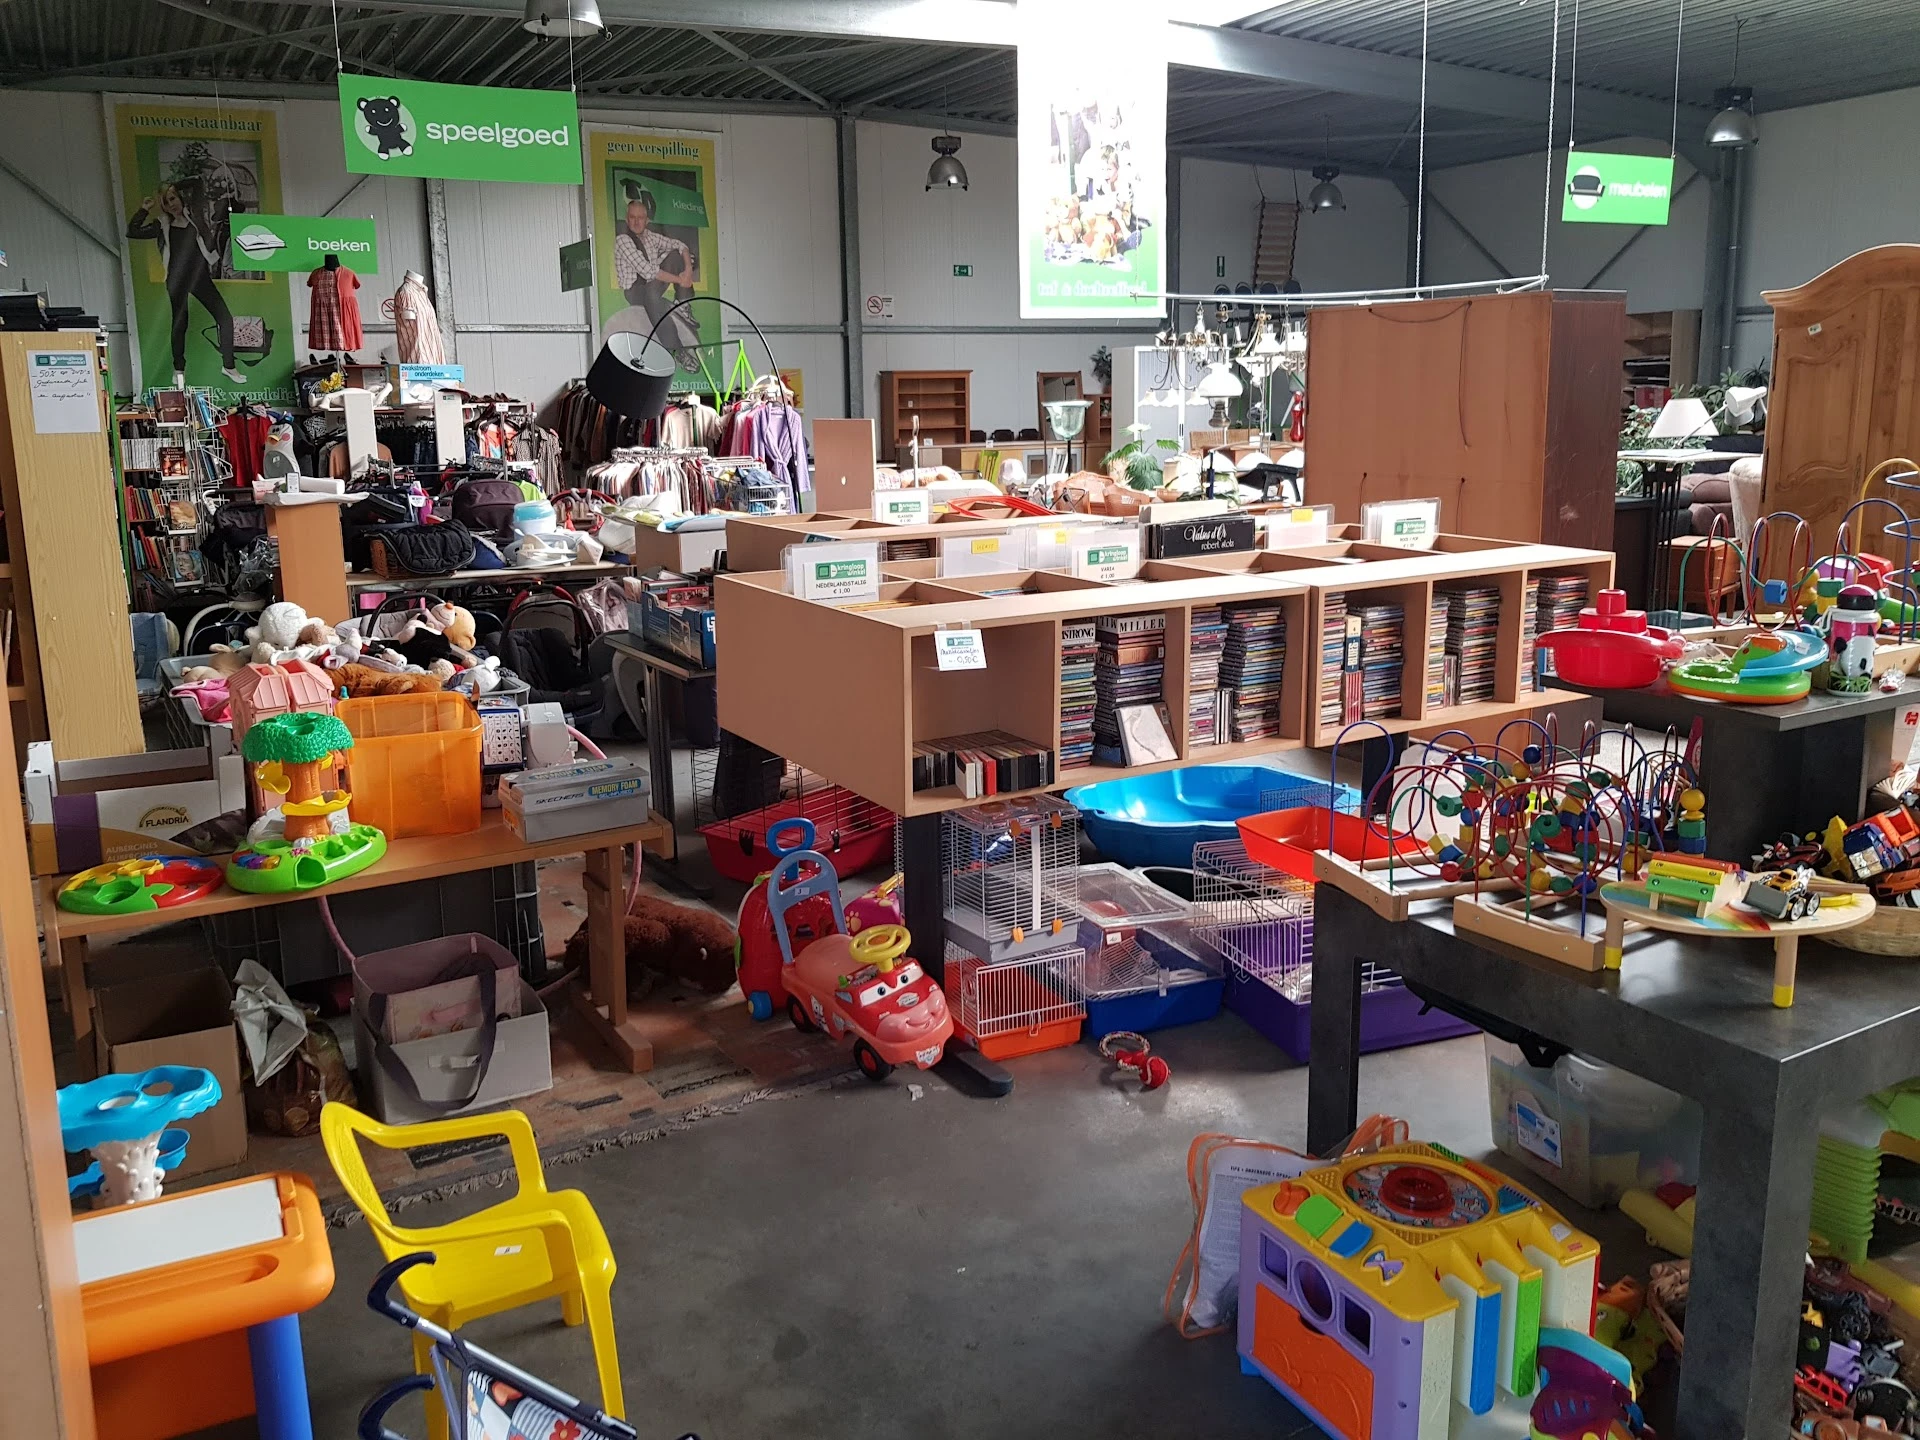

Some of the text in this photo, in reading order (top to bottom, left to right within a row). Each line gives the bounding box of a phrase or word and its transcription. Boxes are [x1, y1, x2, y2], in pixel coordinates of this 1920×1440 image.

[130, 114, 262, 132] onweerstaanbaar
[425, 122, 569, 148] speelgoed
[606, 141, 700, 160] geen verspilling
[307, 237, 371, 252] boeken
[836, 562, 865, 571] kringloop
[815, 579, 867, 589] NEDERLANDSTALIG
[1119, 617, 1165, 633] MILLER
[591, 779, 638, 795] MEMORY FOAM
[535, 792, 585, 805] SKECHERS
[145, 815, 189, 827] FLANDRIA
[105, 841, 159, 855] AUBERGINES
